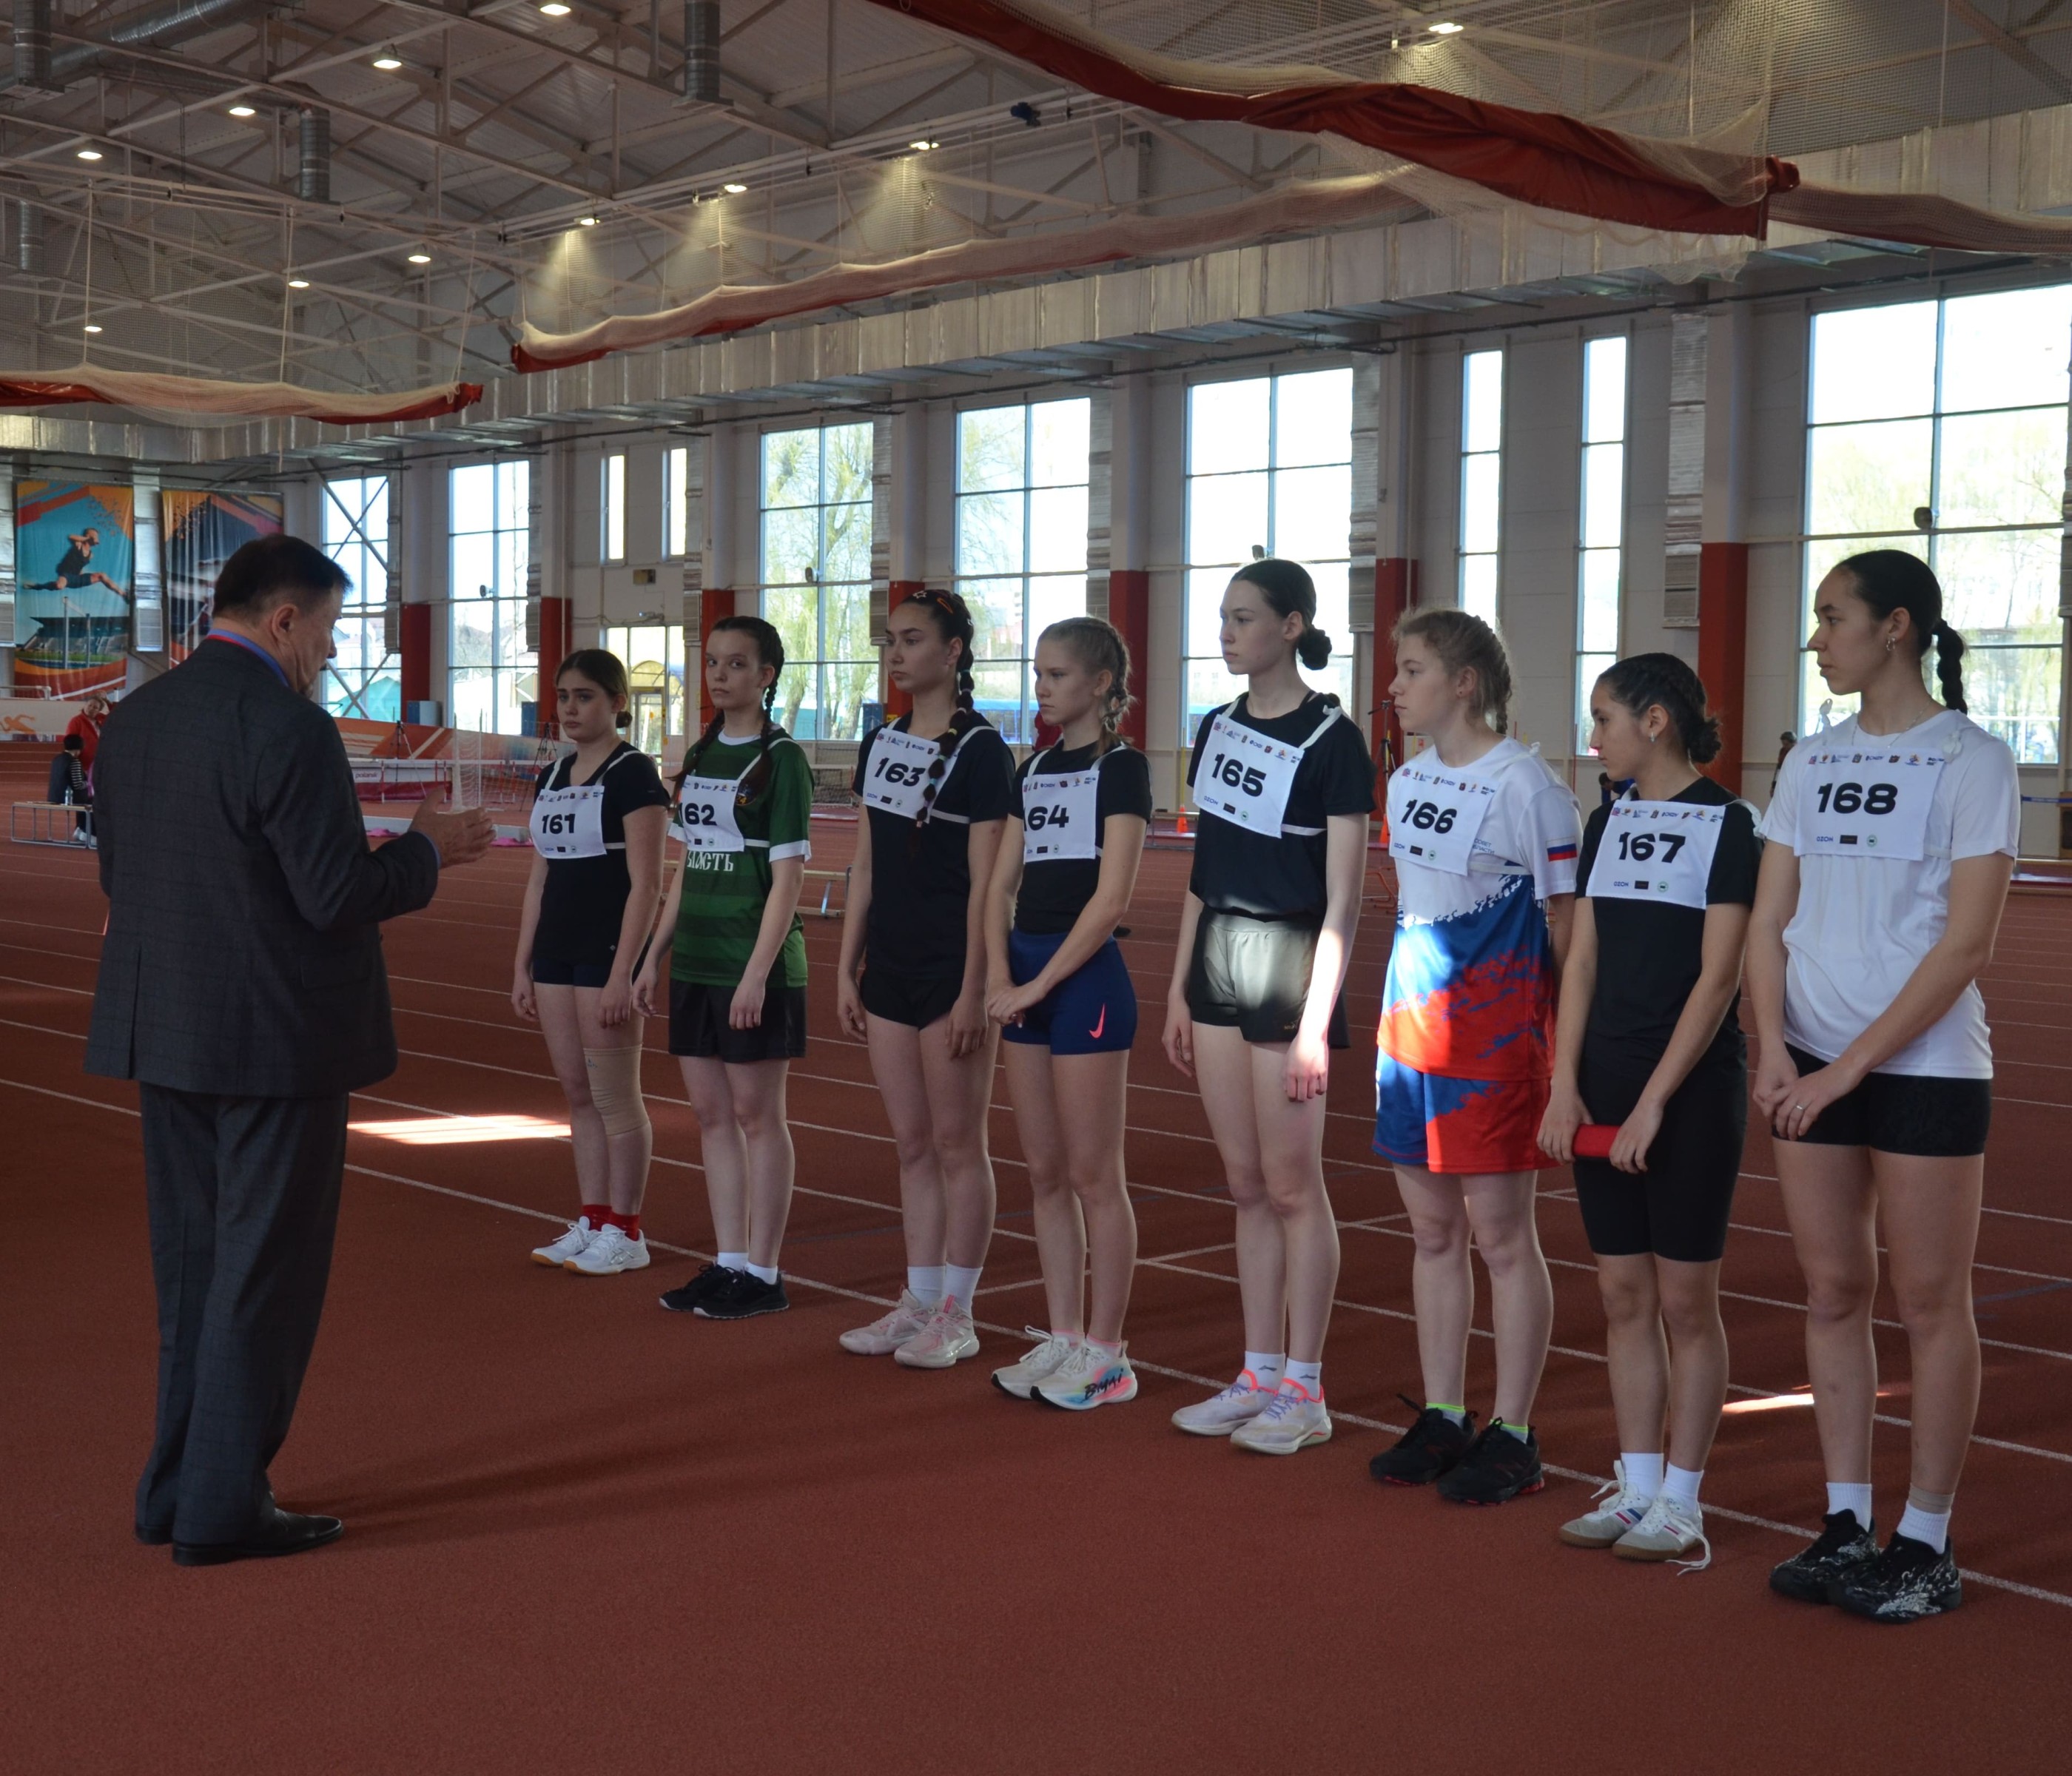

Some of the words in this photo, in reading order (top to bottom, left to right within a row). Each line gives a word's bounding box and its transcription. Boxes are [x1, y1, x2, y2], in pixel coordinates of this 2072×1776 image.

[874, 757, 926, 787] 163
[1211, 753, 1267, 797] 165
[1817, 782, 1898, 815] 168
[542, 813, 576, 835] 161
[1401, 798, 1457, 834] 166
[1618, 832, 1686, 864] 167
